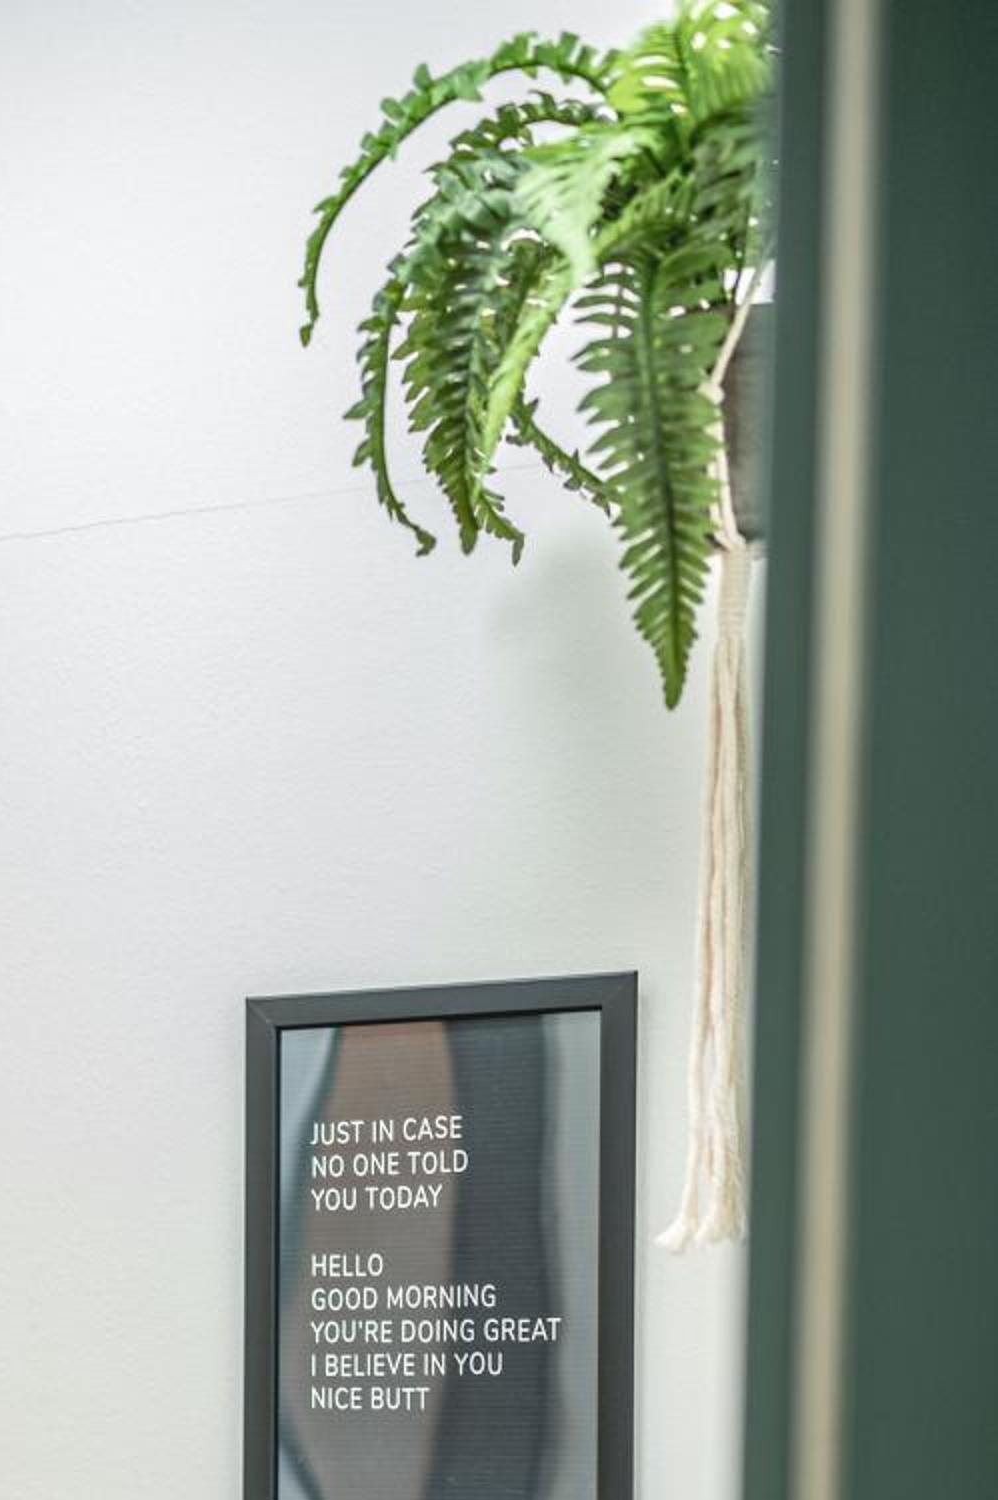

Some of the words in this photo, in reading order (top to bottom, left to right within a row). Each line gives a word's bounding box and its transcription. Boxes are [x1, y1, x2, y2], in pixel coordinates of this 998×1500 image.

[311, 1120, 364, 1145] JUST
[372, 1120, 393, 1142] IN
[403, 1115, 462, 1141] CASE
[312, 1155, 344, 1178] NO
[353, 1152, 399, 1176] ONE
[407, 1150, 468, 1174] TOLD
[311, 1188, 356, 1210] YOU
[365, 1184, 442, 1210] TODAY
[312, 1253, 383, 1277] HELLO
[312, 1287, 378, 1310] GOOD
[387, 1284, 496, 1309] MORNING
[311, 1320, 392, 1343] YOU'RE
[402, 1319, 474, 1343] DOING
[484, 1318, 561, 1342] GREAT
[311, 1354, 317, 1377] I
[326, 1353, 414, 1376] BELIEVE
[424, 1353, 445, 1376] IN
[454, 1352, 502, 1376] YOU
[312, 1387, 362, 1409] NICE
[371, 1387, 430, 1410] BUTT
